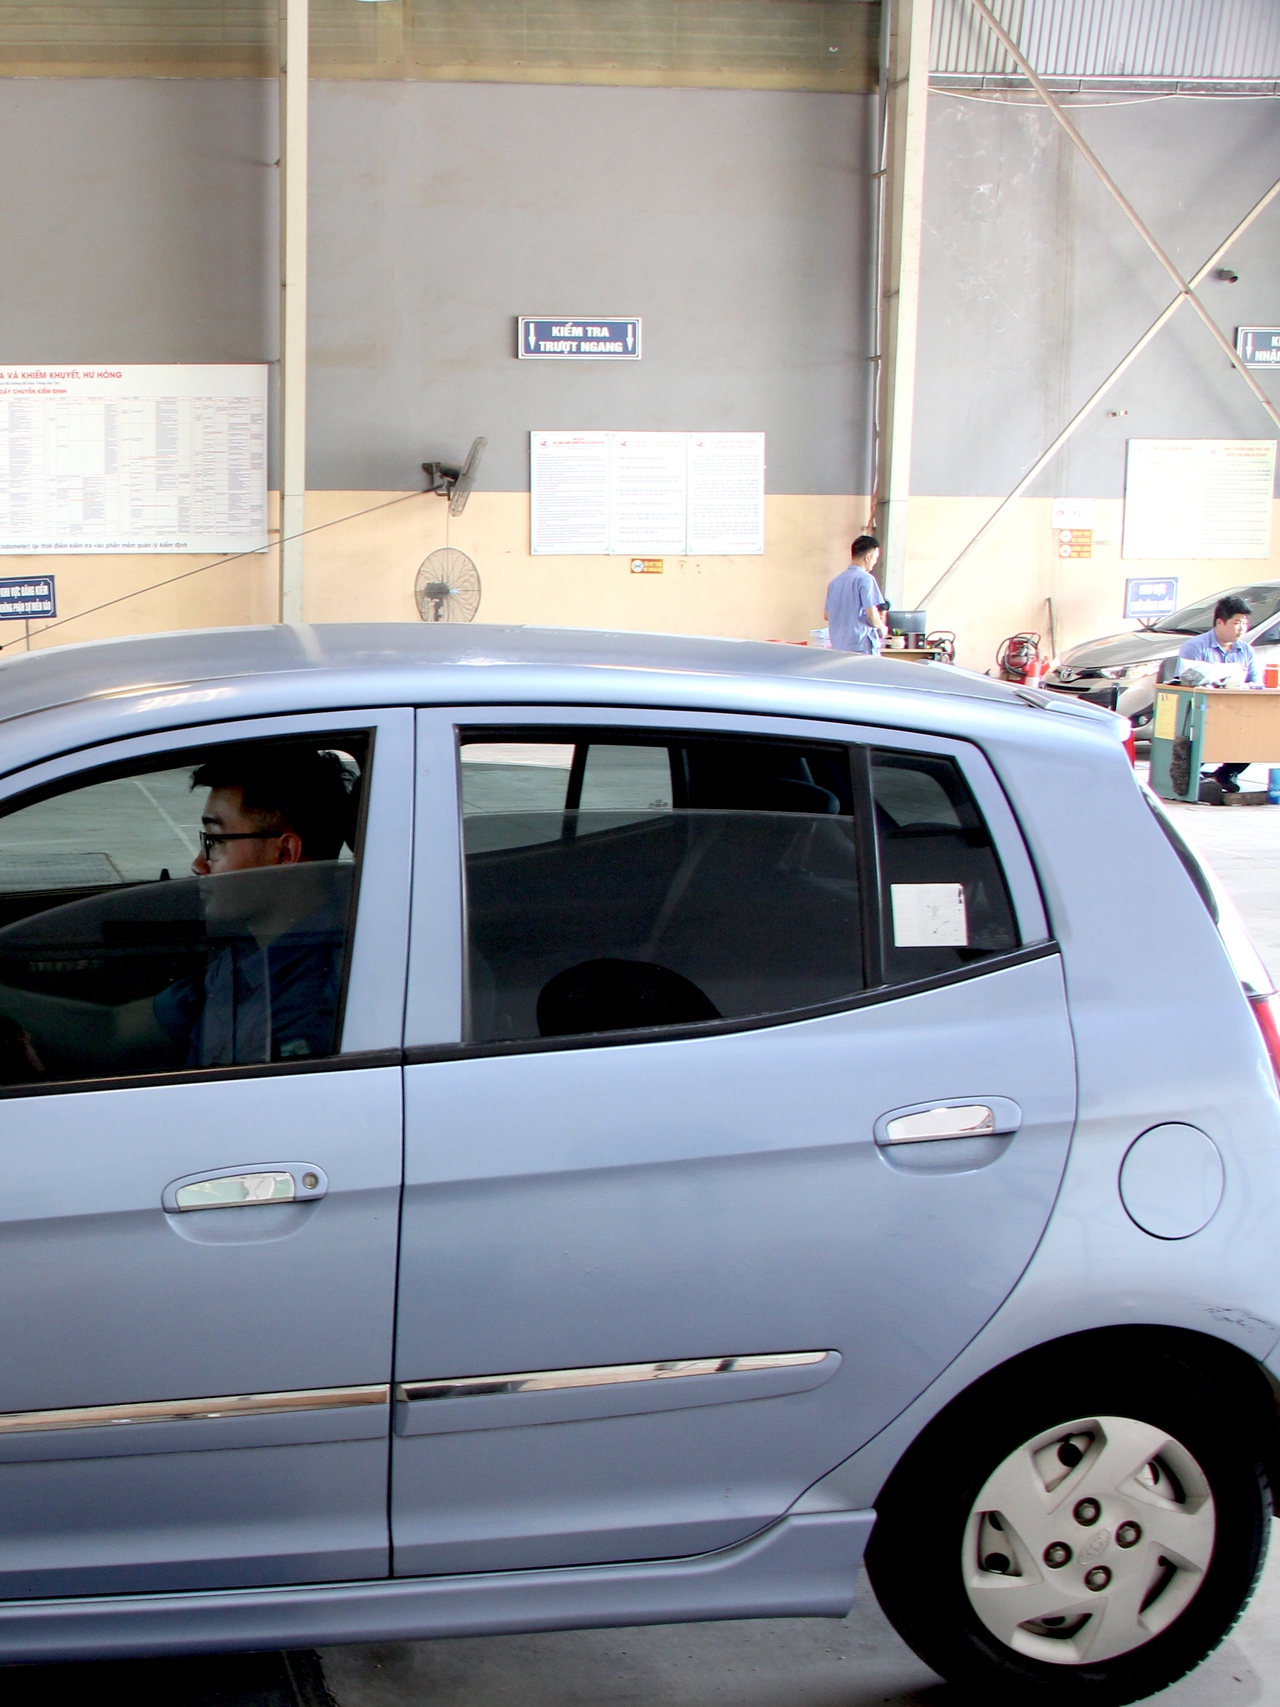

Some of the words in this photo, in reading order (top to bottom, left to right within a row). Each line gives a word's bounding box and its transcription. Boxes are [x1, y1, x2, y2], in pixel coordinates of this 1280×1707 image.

[551, 322, 583, 337] KIỂM
[586, 327, 610, 337] TRA
[538, 340, 578, 353] TRƯỢT
[580, 341, 623, 352] NGANG
[7, 370, 19, 379] VÀ
[83, 371, 95, 379] HƯ
